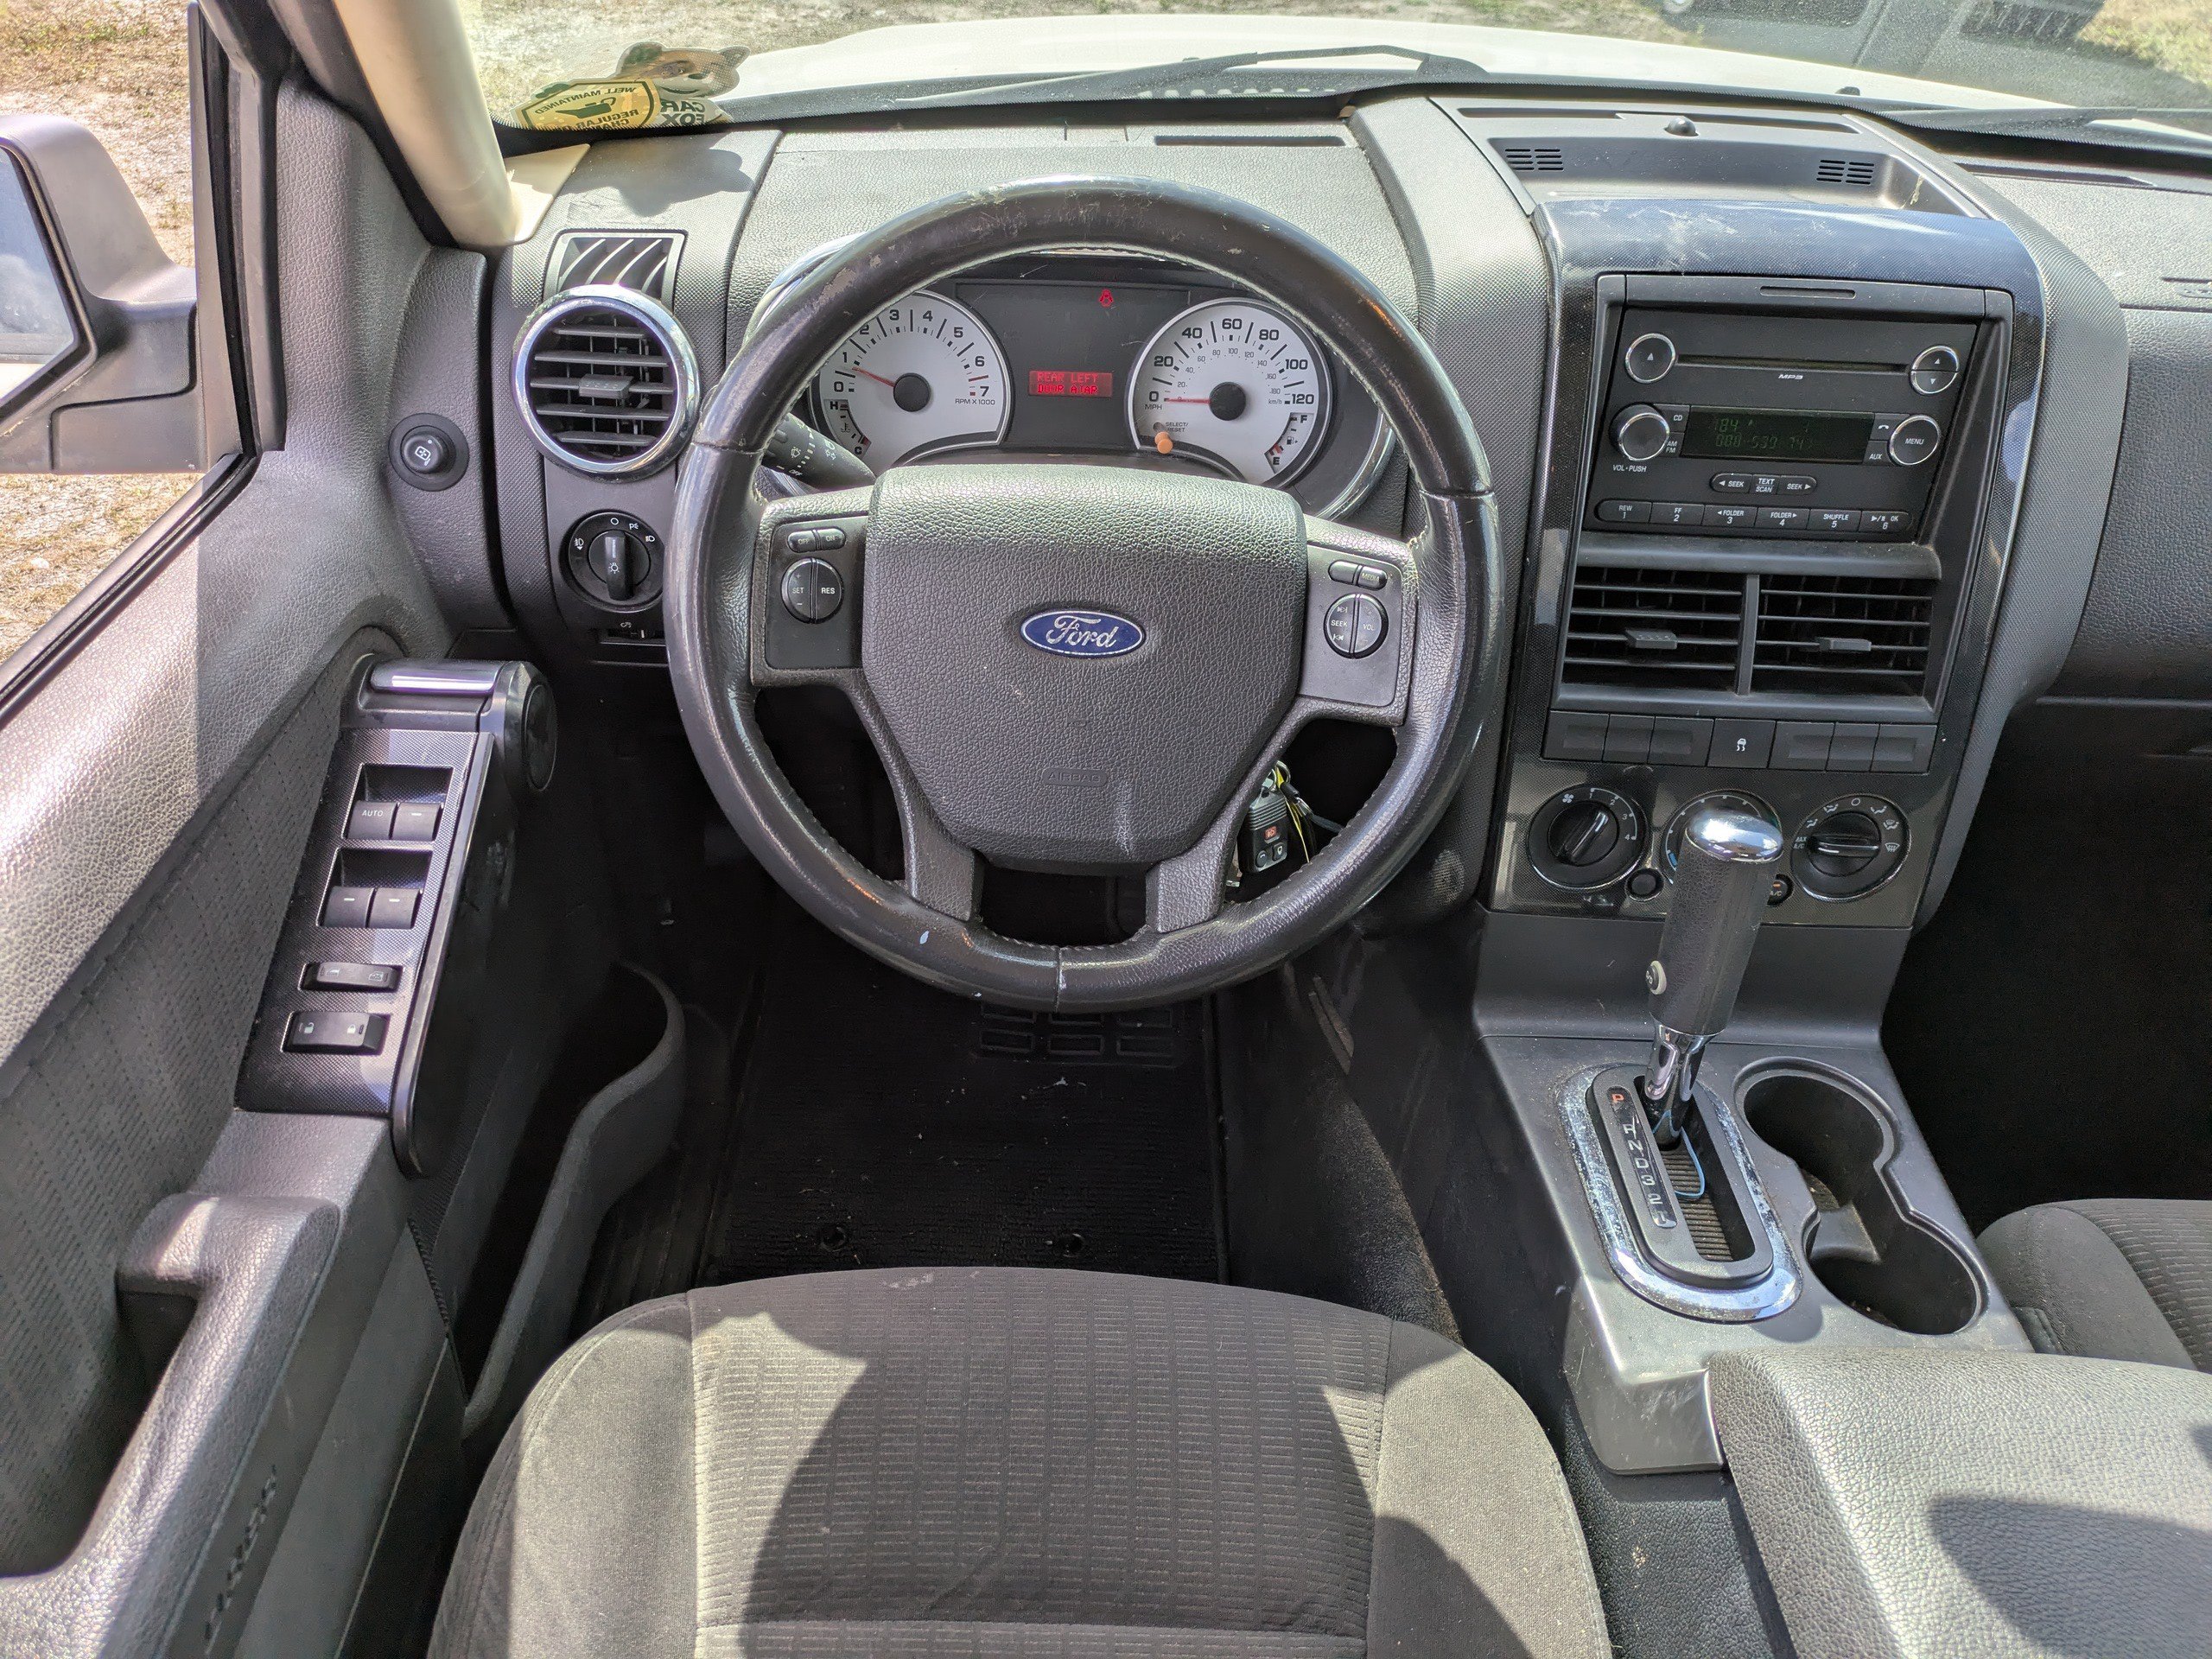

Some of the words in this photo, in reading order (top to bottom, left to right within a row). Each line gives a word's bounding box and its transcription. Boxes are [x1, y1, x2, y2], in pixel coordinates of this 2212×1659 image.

[889, 309, 899, 321] 3
[923, 310, 933, 321] 4
[1222, 318, 1243, 329] 60
[860, 324, 869, 335] 2
[953, 327, 963, 338] 5
[1182, 327, 1203, 339] 40
[1259, 329, 1280, 340] 80
[842, 352, 848, 363] 1
[975, 356, 985, 367] 6
[1154, 356, 1174, 367] 20
[1285, 359, 1308, 370] 100
[1037, 372, 1065, 382] REAR
[1070, 372, 1099, 384] LEFT
[833, 381, 844, 392] 0
[980, 386, 989, 397] 7
[1038, 384, 1065, 393] DOOR
[1070, 385, 1098, 395] AJAR
[1149, 391, 1159, 402] 0
[1292, 393, 1315, 404] 120
[830, 401, 839, 410] H
[1300, 415, 1307, 423] F
[854, 446, 862, 454] C
[1272, 456, 1281, 465] E
[1361, 572, 1380, 582] MEDIA
[1046, 614, 1120, 648] Ford
[1048, 772, 1101, 783] AIRBAG
[1611, 1093, 1625, 1104] P
[1628, 1140, 1643, 1151] N
[1634, 1157, 1649, 1169] D
[1641, 1174, 1656, 1186] 3
[1647, 1193, 1663, 1205] 2
